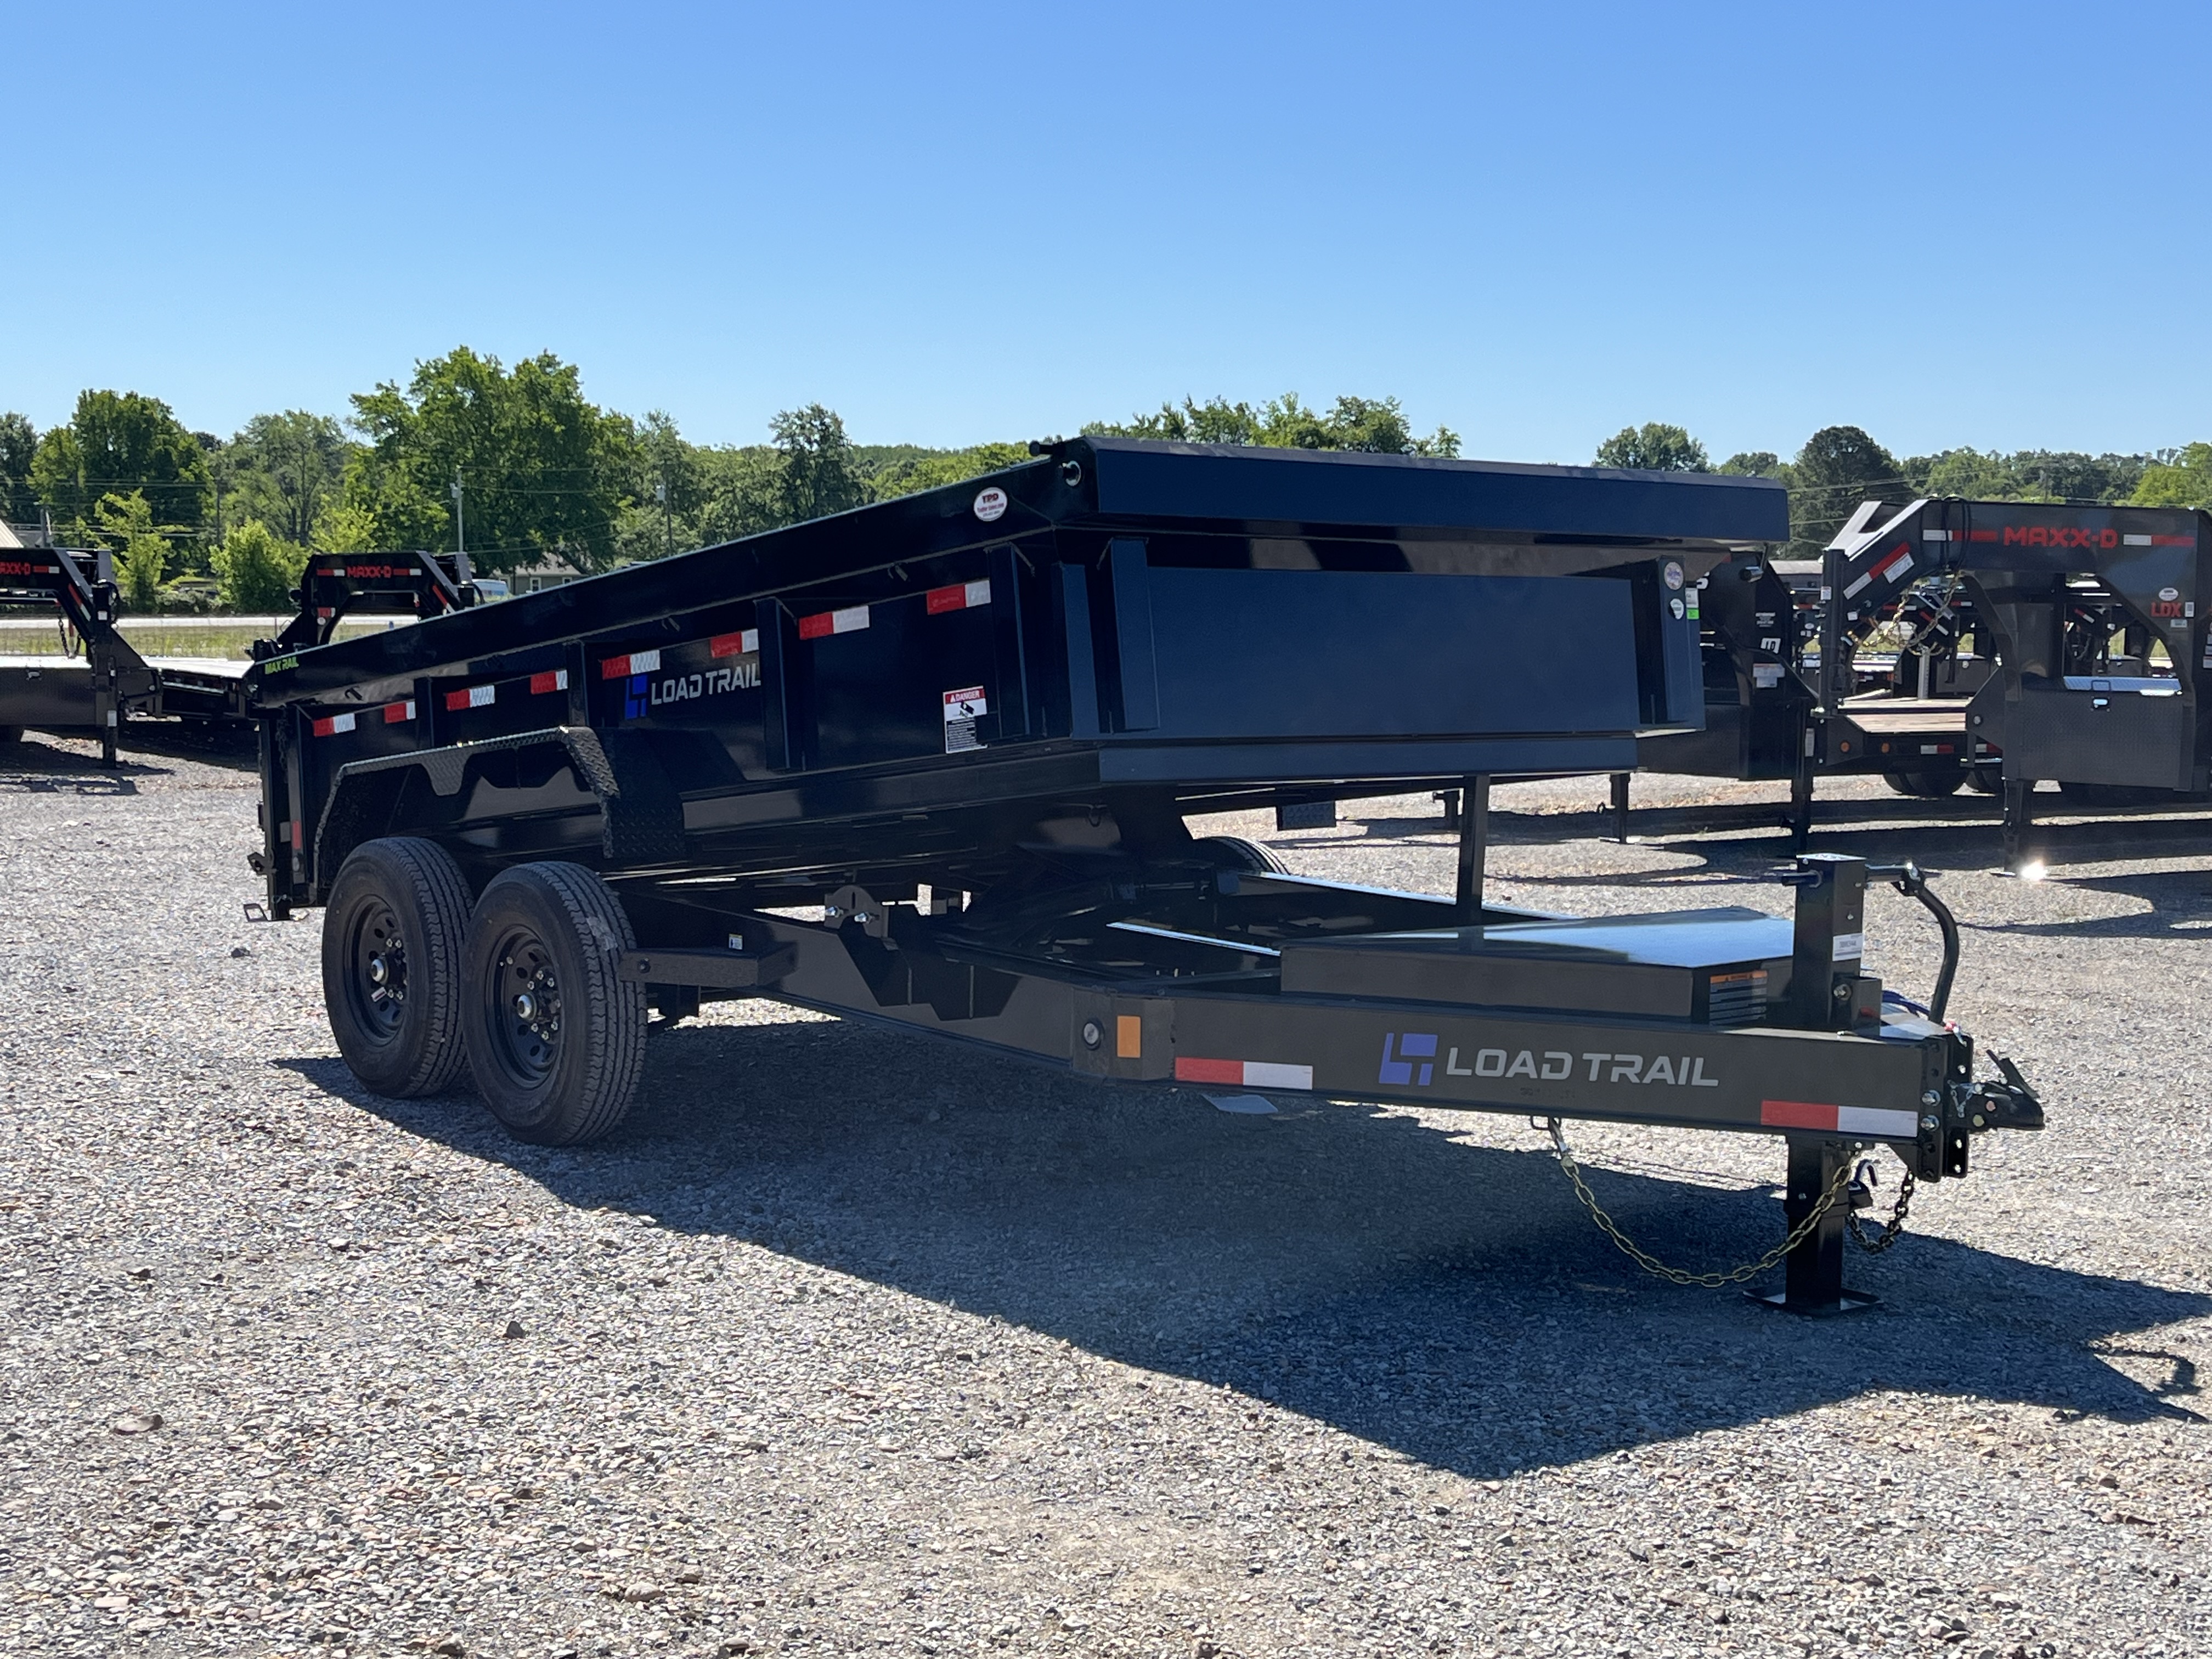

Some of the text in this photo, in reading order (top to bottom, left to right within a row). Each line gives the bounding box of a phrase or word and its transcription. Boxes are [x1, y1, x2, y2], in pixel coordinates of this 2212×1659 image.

[2004, 526, 2118, 549] MAXX-D
[347, 565, 392, 578] MAXX-D
[2151, 602, 2182, 617] LDX
[264, 656, 300, 675] MAX RAIL
[651, 663, 761, 705] LOAD TRAIL
[955, 690, 980, 702] DANGER
[1446, 1047, 1719, 1087] LOAD TRAIL
